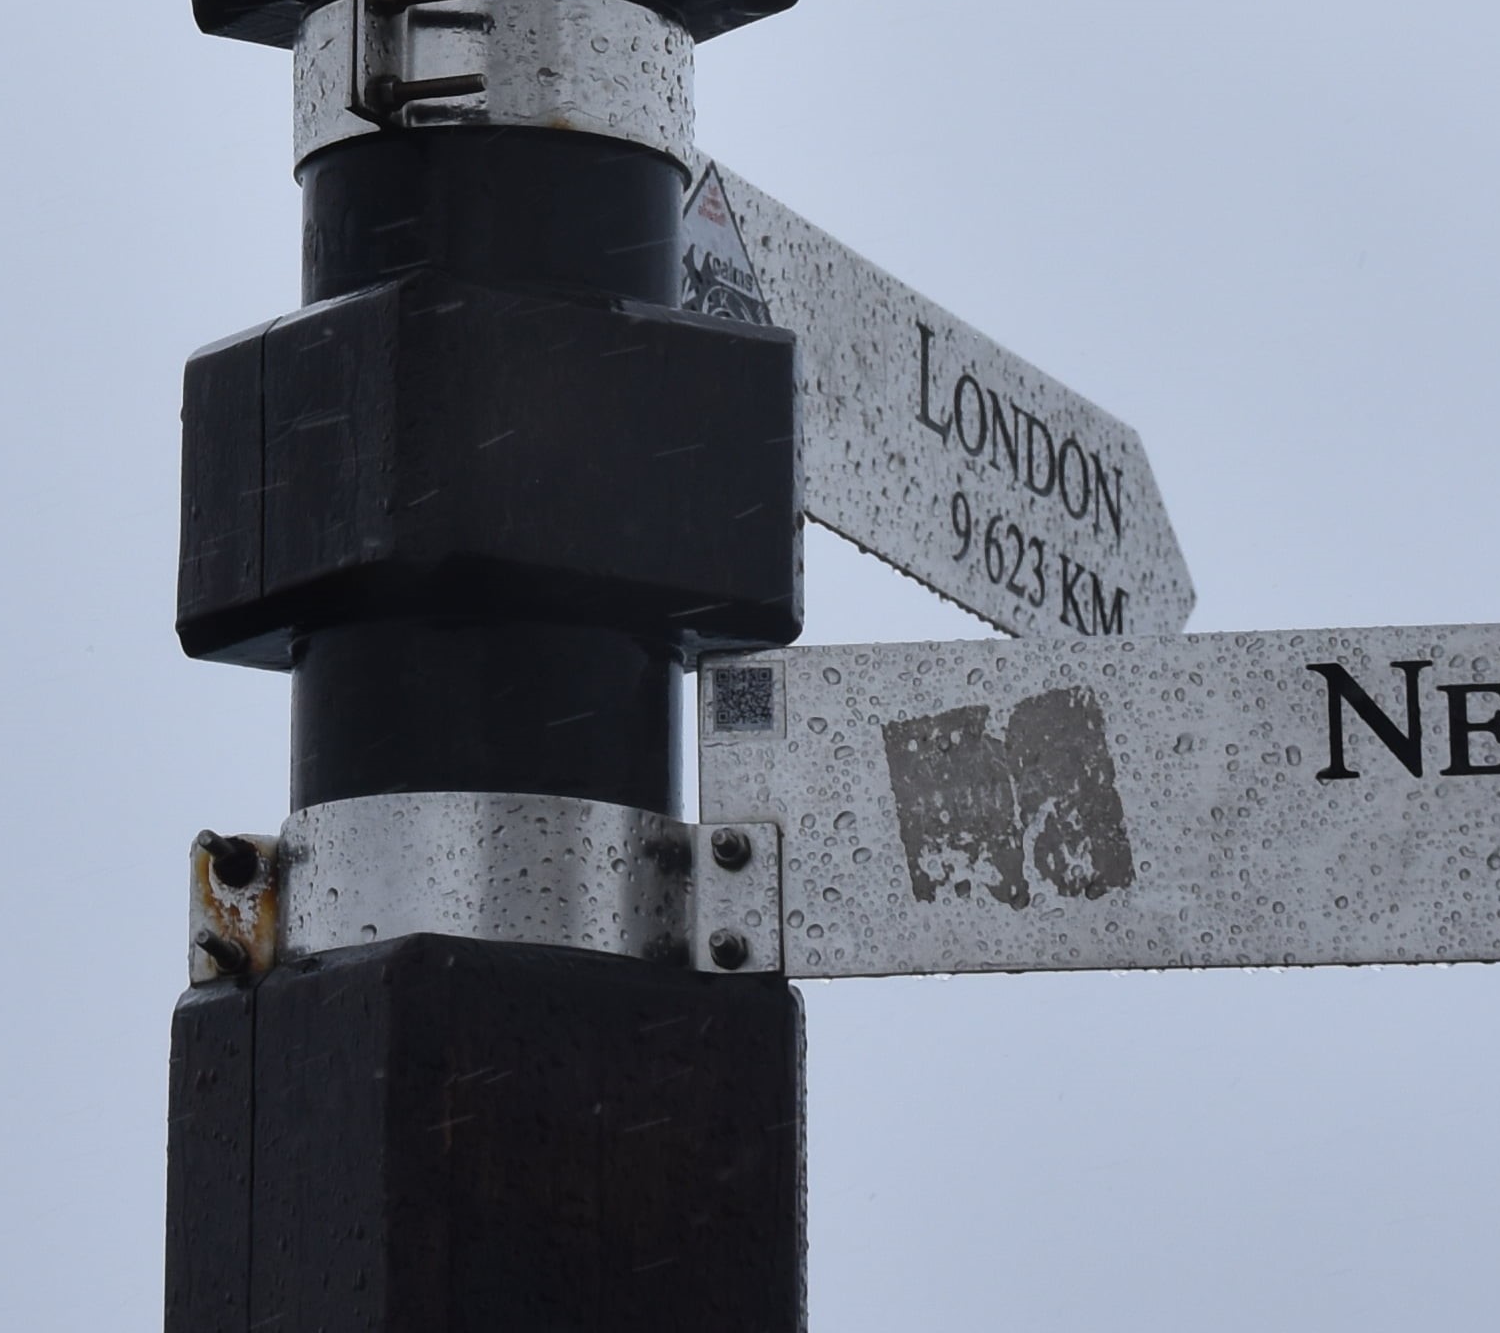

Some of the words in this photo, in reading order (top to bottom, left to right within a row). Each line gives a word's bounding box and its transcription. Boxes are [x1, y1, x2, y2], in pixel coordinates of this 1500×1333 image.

[914, 319, 1124, 551] LONDON
[950, 491, 973, 563] 9
[983, 513, 1047, 609] 623
[1057, 552, 1130, 637] KM
